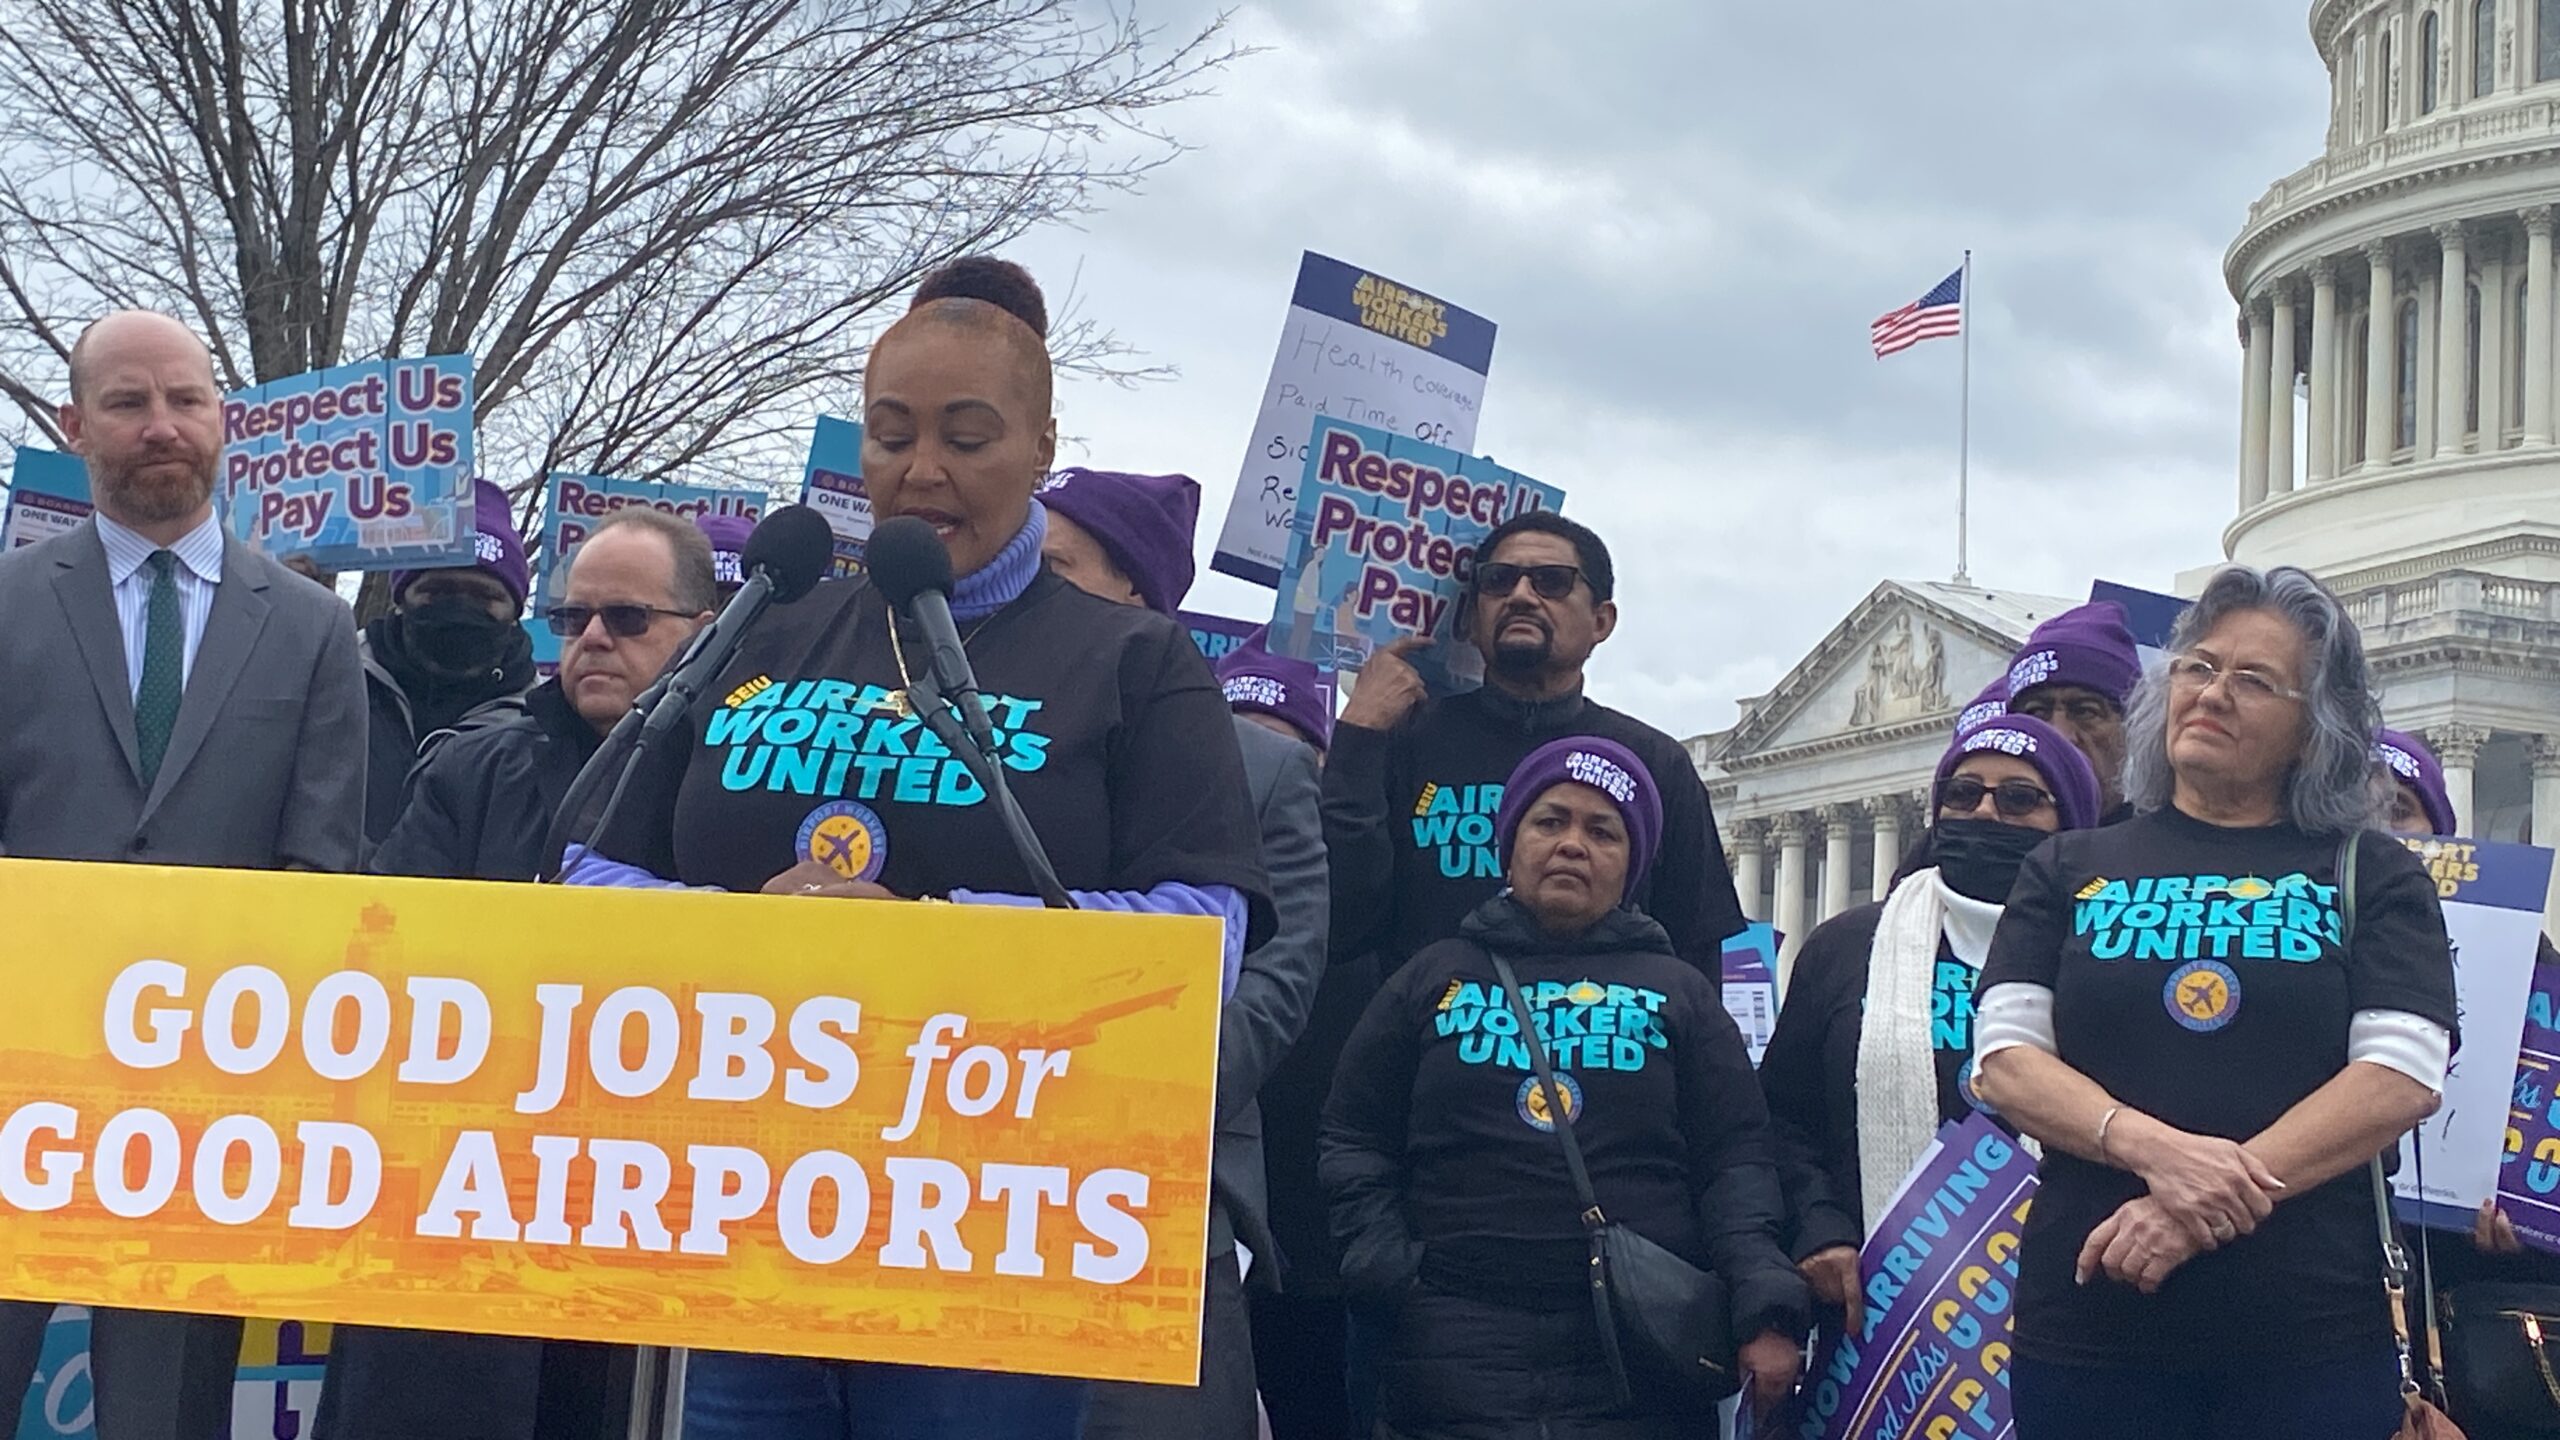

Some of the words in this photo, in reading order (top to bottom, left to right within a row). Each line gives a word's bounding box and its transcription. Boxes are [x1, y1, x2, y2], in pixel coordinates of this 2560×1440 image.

[1352, 290, 1449, 338] WORKERS
[1357, 275, 1447, 319] AIRPORT
[1361, 308, 1432, 348] UNITED
[1293, 324, 1403, 385] Health
[224, 376, 384, 444] Respect
[399, 367, 464, 412] Us
[1277, 383, 1329, 414] Paid
[1342, 397, 1399, 431] Time
[1415, 422, 1452, 448] Off
[228, 431, 378, 497] Protect
[392, 422, 457, 467] Us
[1267, 436, 1309, 459] Sic
[1260, 476, 1297, 504] Re
[1319, 431, 1506, 527] Respect
[21, 508, 48, 522] ONE
[51, 514, 78, 527] WAY
[262, 490, 334, 538] Pay
[349, 475, 412, 519] Us
[818, 493, 849, 510] ONE
[852, 500, 873, 514] WA
[1316, 494, 1476, 583] Protec
[1356, 565, 1448, 638] Pay
[725, 675, 773, 708] SEIU
[739, 679, 1043, 730] AIRPT
[1227, 692, 1276, 706] UNITED
[705, 708, 1052, 773] WORKES
[721, 745, 988, 807] UNITED
[1427, 783, 1504, 815] AIR
[1572, 768, 1625, 802] UNITED
[1412, 814, 1494, 849] WO
[2394, 837, 2477, 862] PORT
[1439, 845, 1503, 878] UN
[2422, 859, 2480, 881] ERS
[2091, 872, 2339, 905] AIRPORT
[2075, 897, 2343, 947] WORKERS
[2091, 926, 2322, 963] UNITED
[103, 959, 493, 1085] GOOD
[515, 983, 862, 1115] JOBS
[881, 1012, 1071, 1142] for
[1435, 1006, 1669, 1049] WORKERS
[1458, 1034, 1646, 1072] UNTED
[0, 1101, 383, 1230] GOOD
[415, 1130, 1150, 1285] AIRPORTS
[1863, 1133, 2014, 1344] ARRIVING
[1932, 1199, 2032, 1349] GOO
[1900, 1342, 1949, 1414] Jobs
